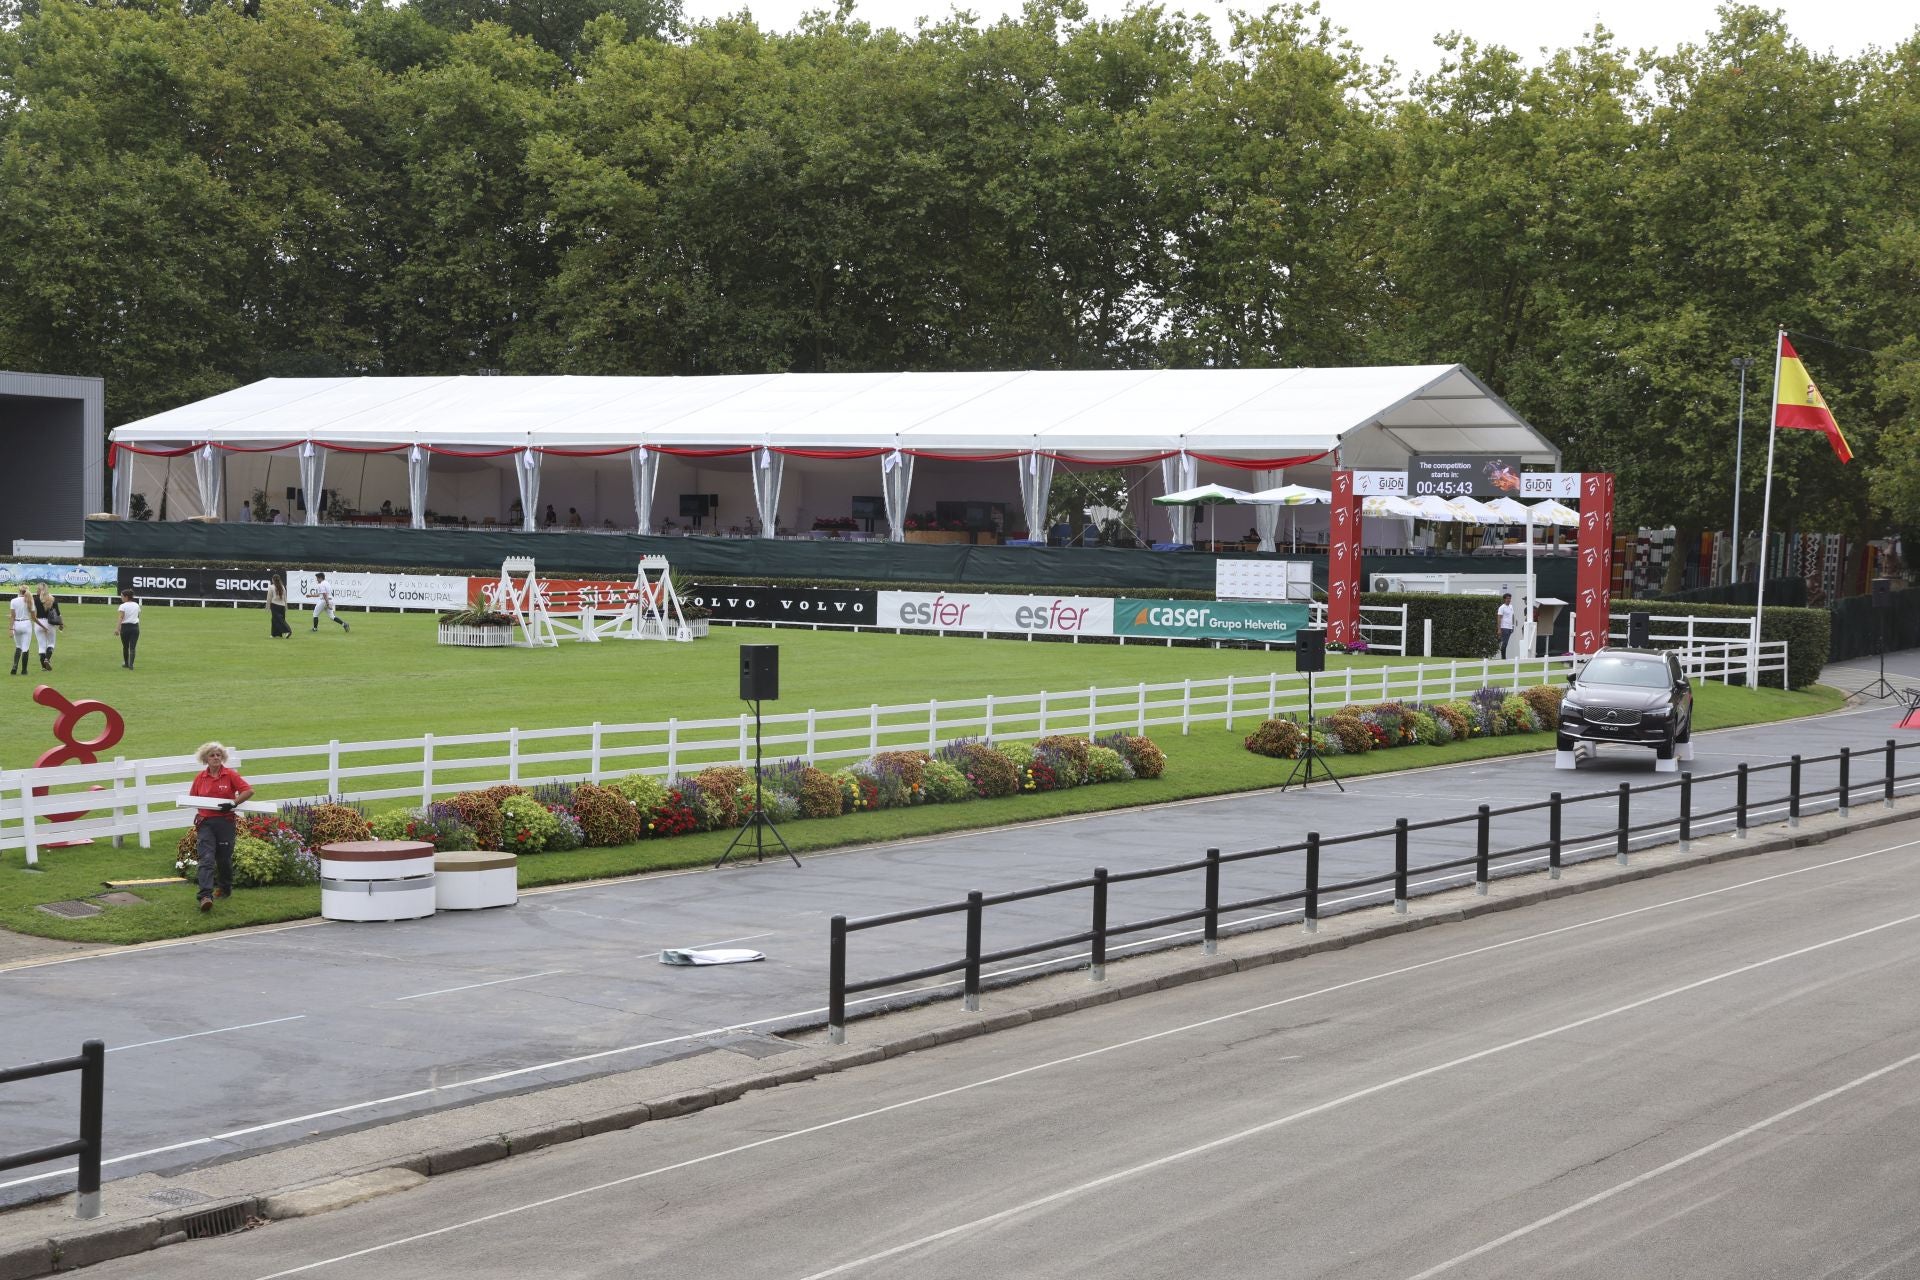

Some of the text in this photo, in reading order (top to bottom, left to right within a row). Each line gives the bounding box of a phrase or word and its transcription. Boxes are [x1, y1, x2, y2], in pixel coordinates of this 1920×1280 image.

[1433, 462, 1471, 471] competition
[1416, 481, 1473, 494] 00:45:43
[132, 576, 187, 589] SIROKO
[215, 579, 271, 591] SIROKO
[677, 596, 756, 609] VOLVO
[780, 599, 864, 613] VOLVO
[899, 596, 970, 626] esfer
[1015, 600, 1090, 631] esfer
[1149, 607, 1287, 631] caser Grupo Helvetia
